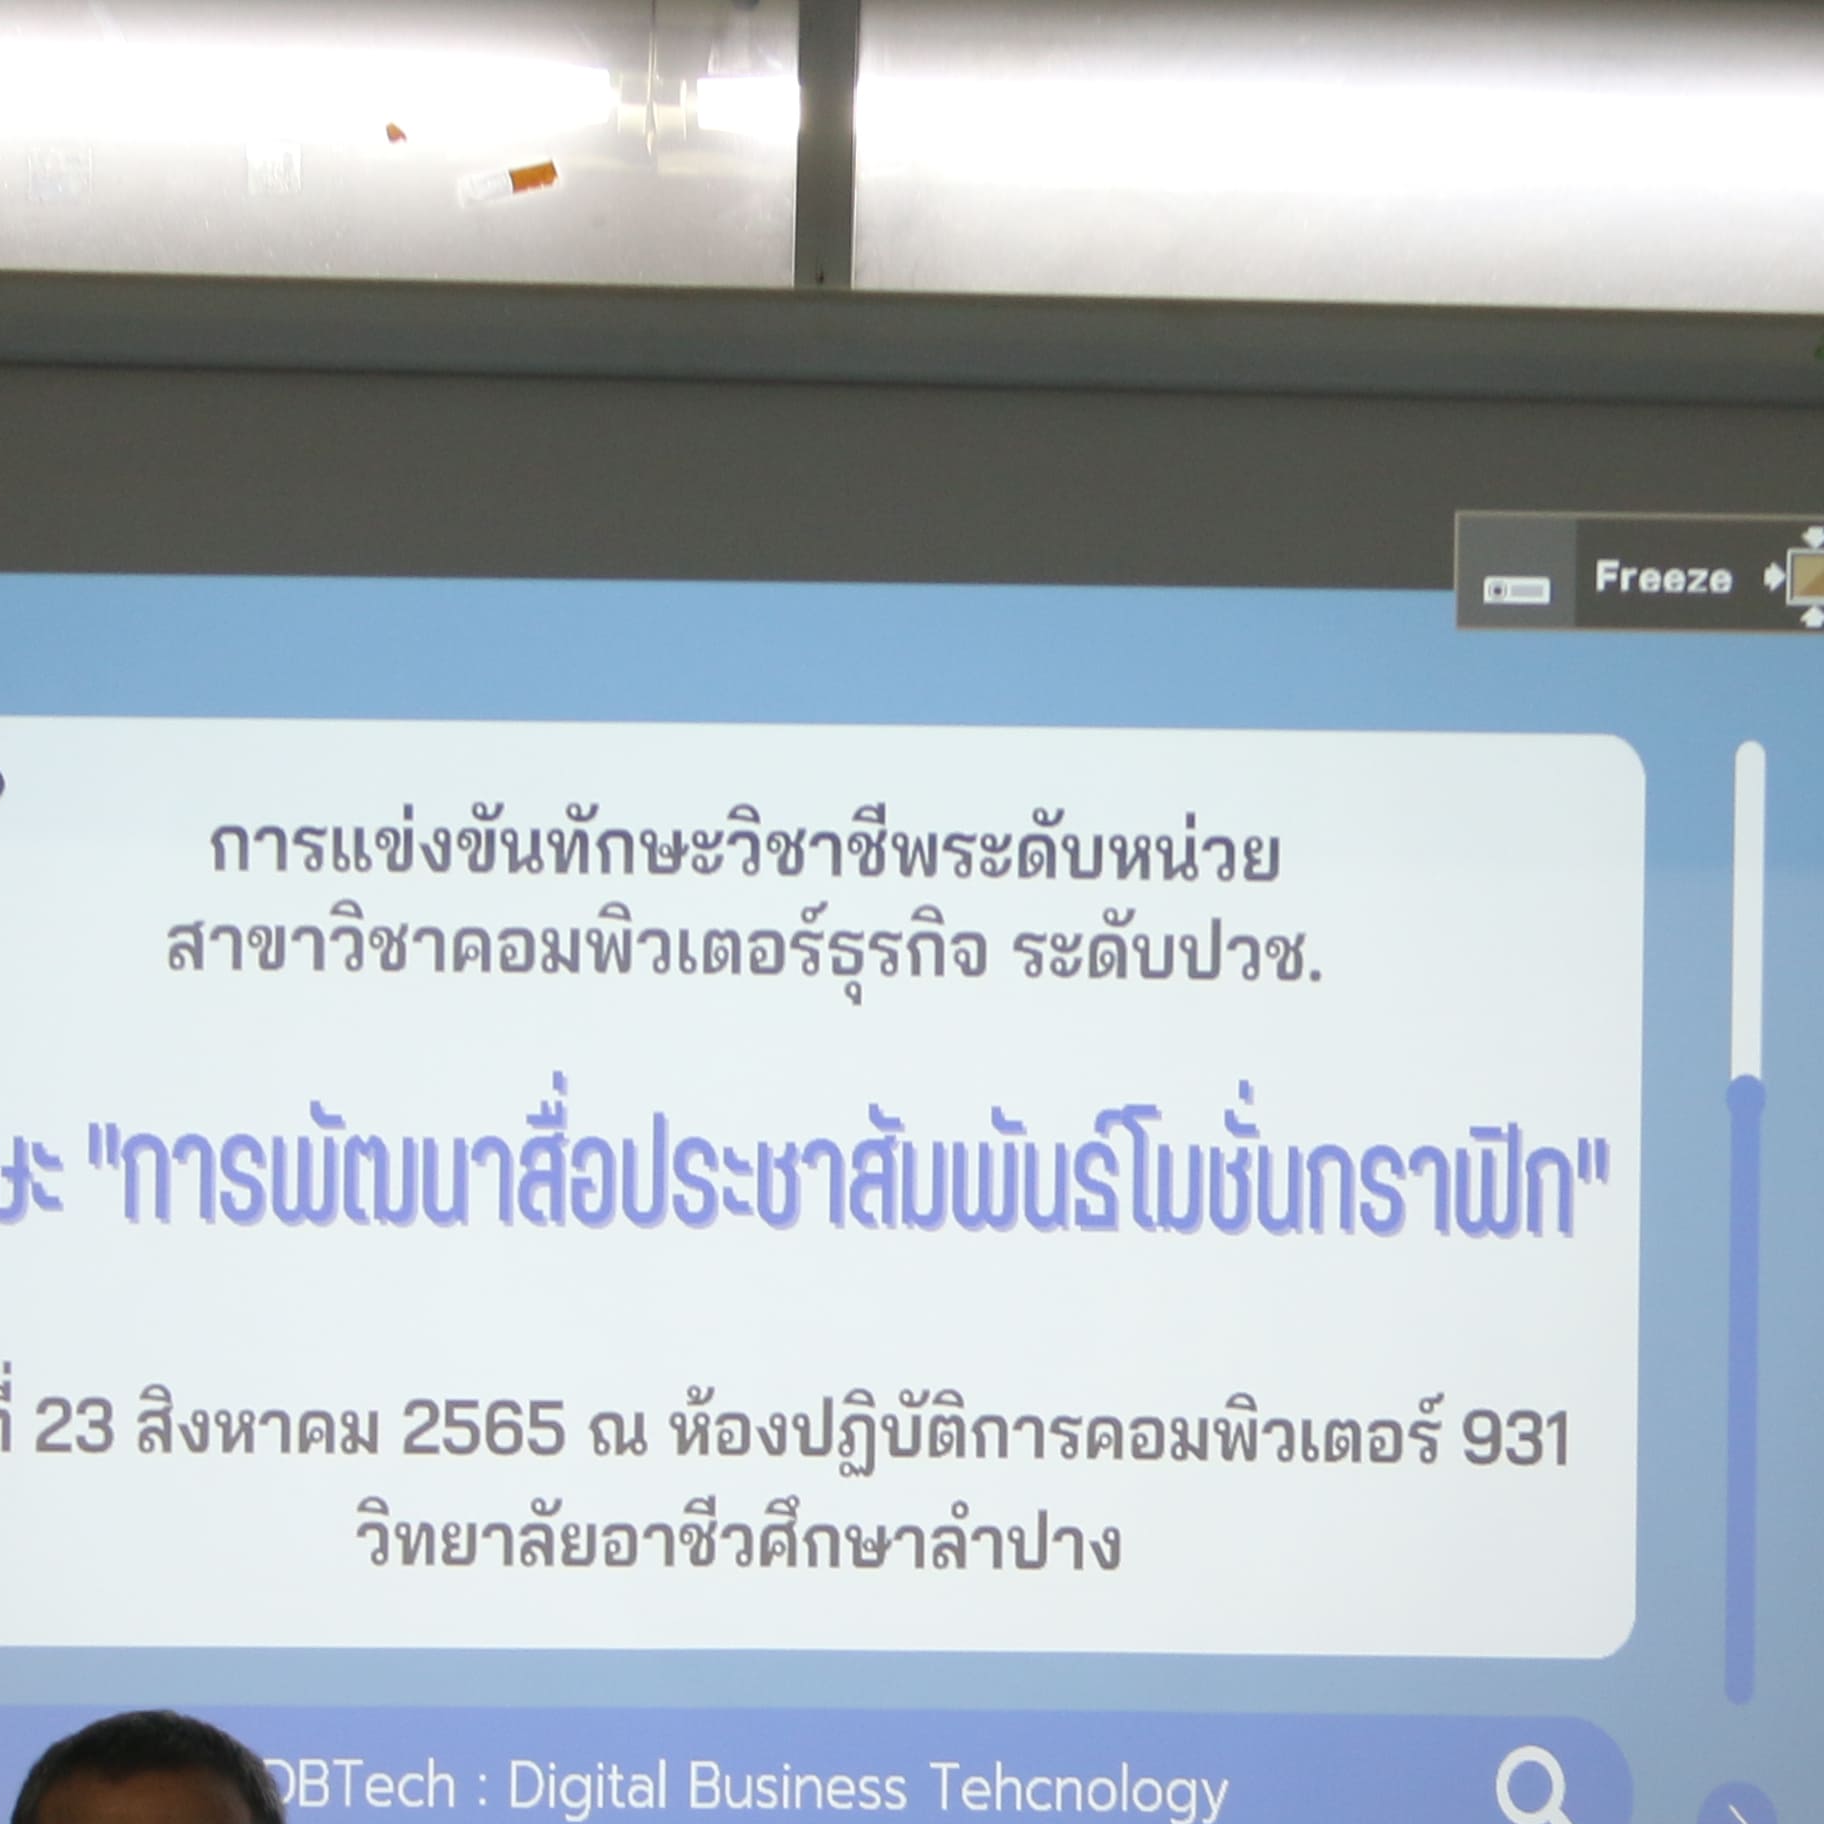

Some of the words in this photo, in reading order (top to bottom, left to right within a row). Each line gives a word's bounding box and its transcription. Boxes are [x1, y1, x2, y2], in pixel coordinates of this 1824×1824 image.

[1595, 558, 1733, 594] Freeze
[210, 802, 1282, 882] การแข่งขันทักษะวิชาชีพระดับหน่วย
[166, 900, 988, 1005] สาขาวิชาคอมพิวเตอร์ธุรกิจ
[1013, 907, 1324, 983] ระดับปวช.
[87, 1070, 1610, 1240] "การพัฒนาสื่อประชาสัมพันธ์โมชั่นกราฟิก"
[34, 1396, 116, 1454] 23
[136, 1382, 380, 1456] สิงหาคม
[402, 1398, 568, 1457] 2565
[587, 1408, 650, 1457] ณ
[668, 1385, 1445, 1479] ห้องปฏิบัติการคอมพิวเตอร์
[1461, 1408, 1570, 1467] 931
[355, 1495, 1123, 1572] วิทยาลัยอาชีวศึกษาลำปาง
[510, 1758, 669, 1822] Digital
[689, 1760, 909, 1812] Business
